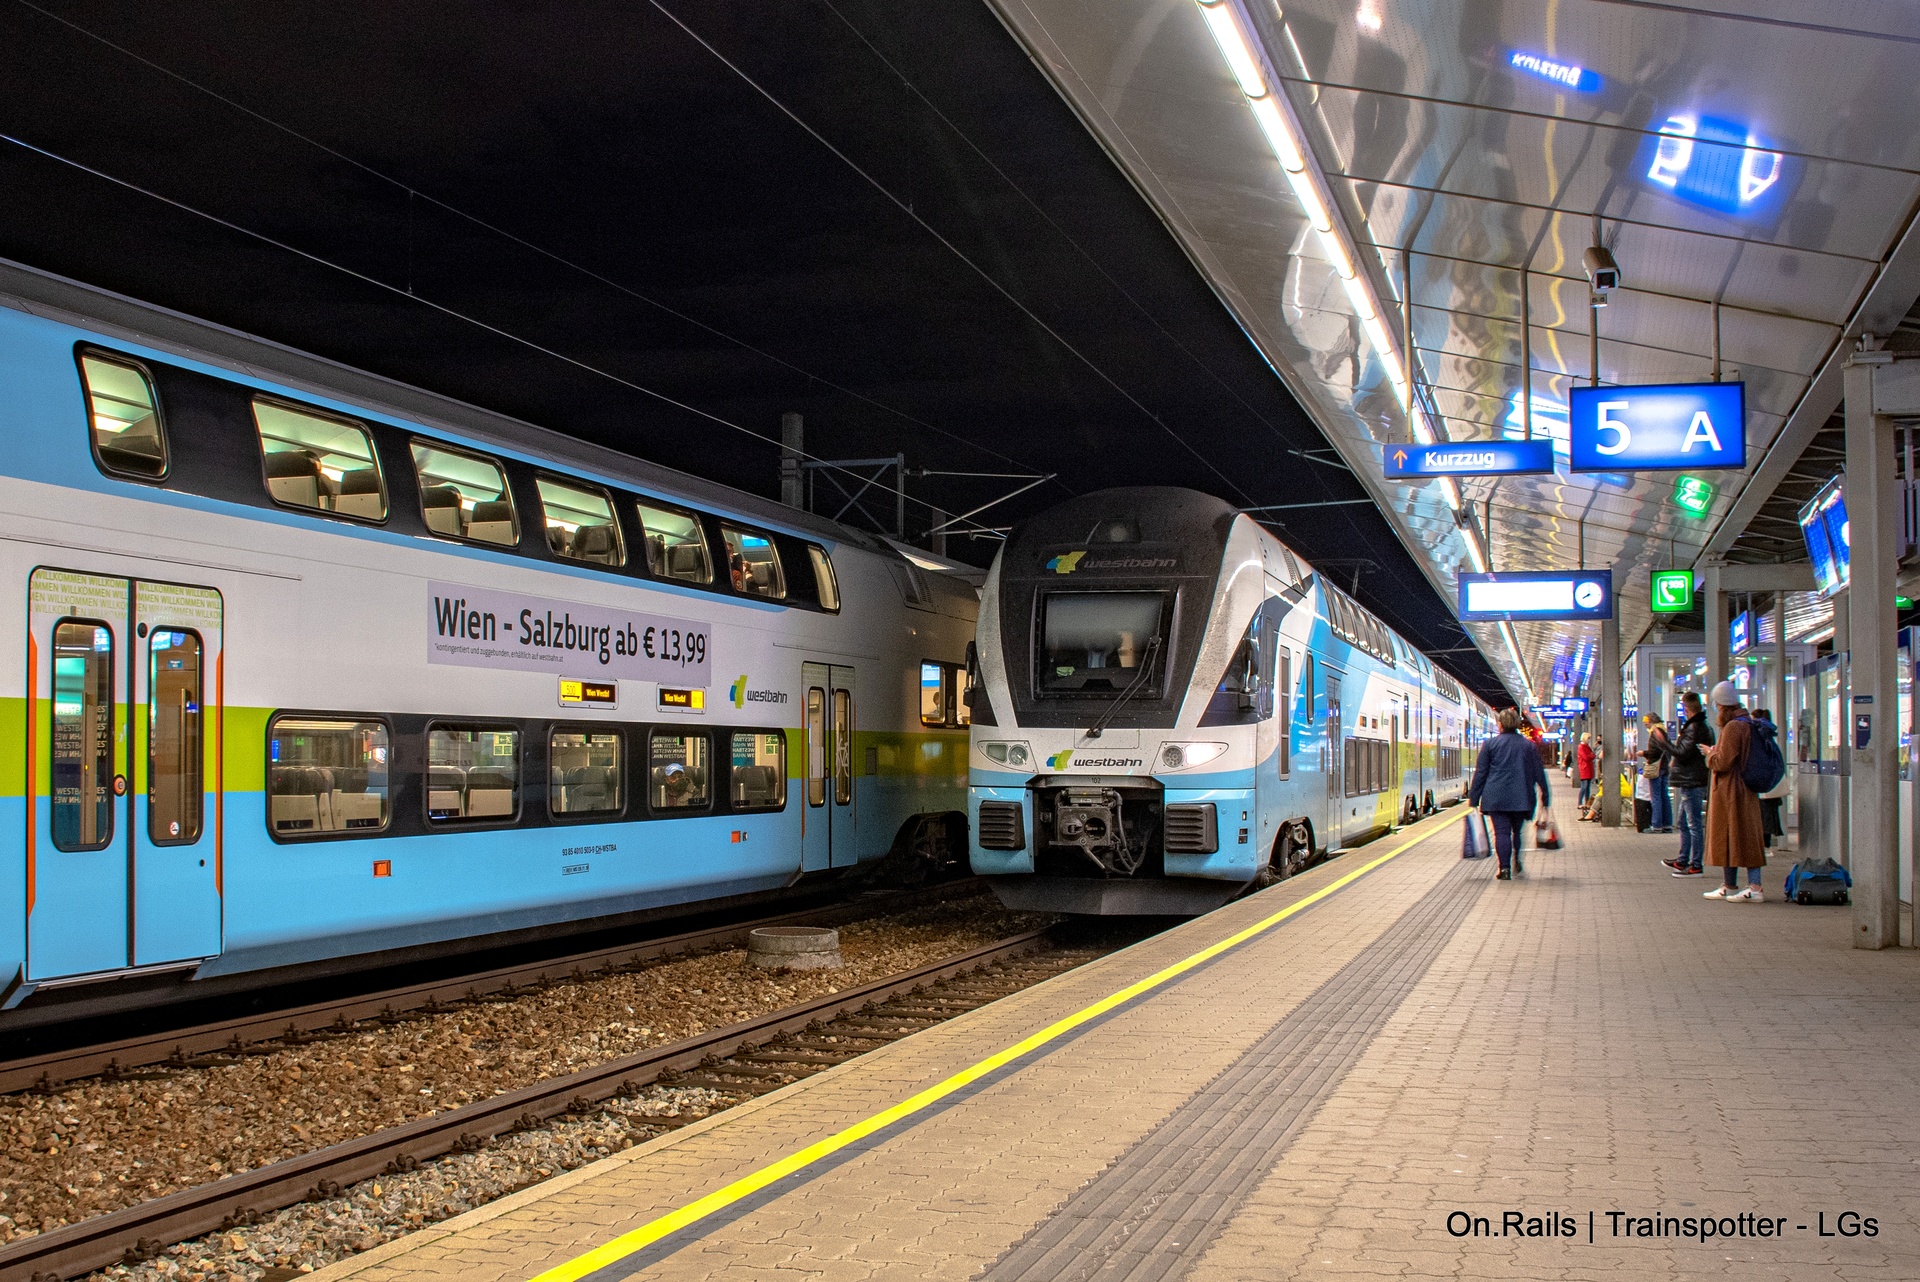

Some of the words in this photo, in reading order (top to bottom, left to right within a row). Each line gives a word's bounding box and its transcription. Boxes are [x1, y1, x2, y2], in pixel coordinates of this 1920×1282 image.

[1596, 401, 1631, 455] 5
[1680, 411, 1722, 452] A
[1425, 452, 1495, 468] Kurzzug
[1083, 558, 1178, 569] westbahn
[35, 570, 87, 585] WILLKOMMEN
[60, 584, 110, 598] WILLKOMMEN
[138, 582, 184, 596] WILLKOMMEN
[434, 596, 496, 642] Wien
[519, 608, 611, 665] Salzburg
[615, 622, 638, 657] ab
[643, 626, 655, 659] €
[470, 647, 480, 655] und
[531, 652, 539, 660] auf
[747, 690, 787, 703] westbahn
[1073, 757, 1142, 767] westbahn
